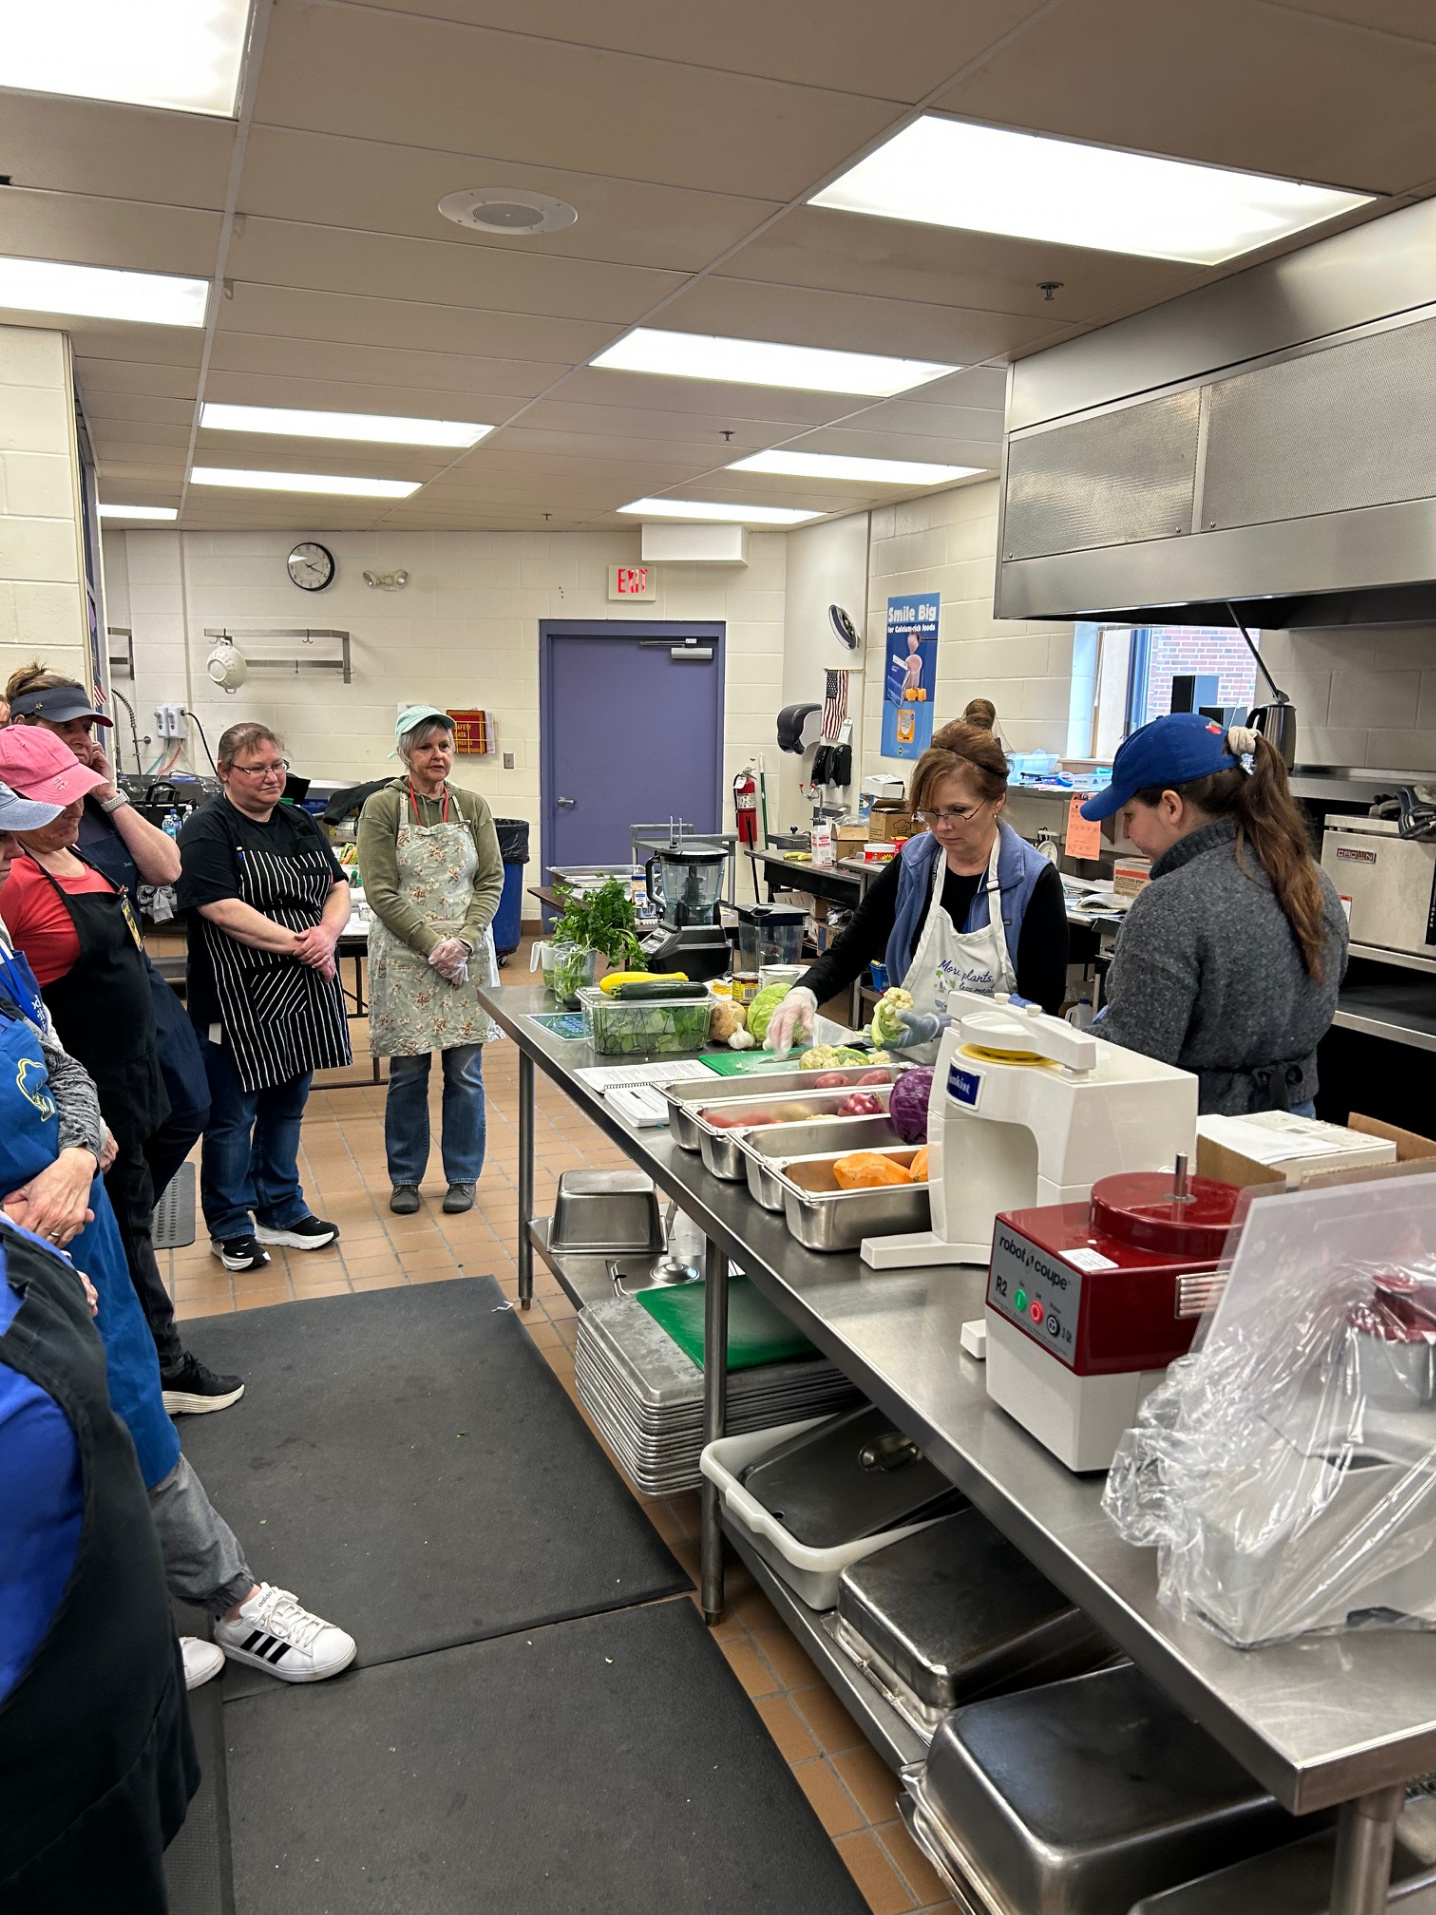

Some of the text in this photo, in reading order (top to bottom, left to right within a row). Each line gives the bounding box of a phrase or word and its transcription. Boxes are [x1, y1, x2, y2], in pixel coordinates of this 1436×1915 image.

[617, 568, 648, 593] EXIT
[888, 603, 936, 622] Smile Big
[959, 981, 995, 994] less meat
[999, 1235, 1026, 1263] robot
[1034, 1260, 1067, 1291] coupe
[996, 1275, 1008, 1297] R2
[258, 1590, 273, 1608] adida
